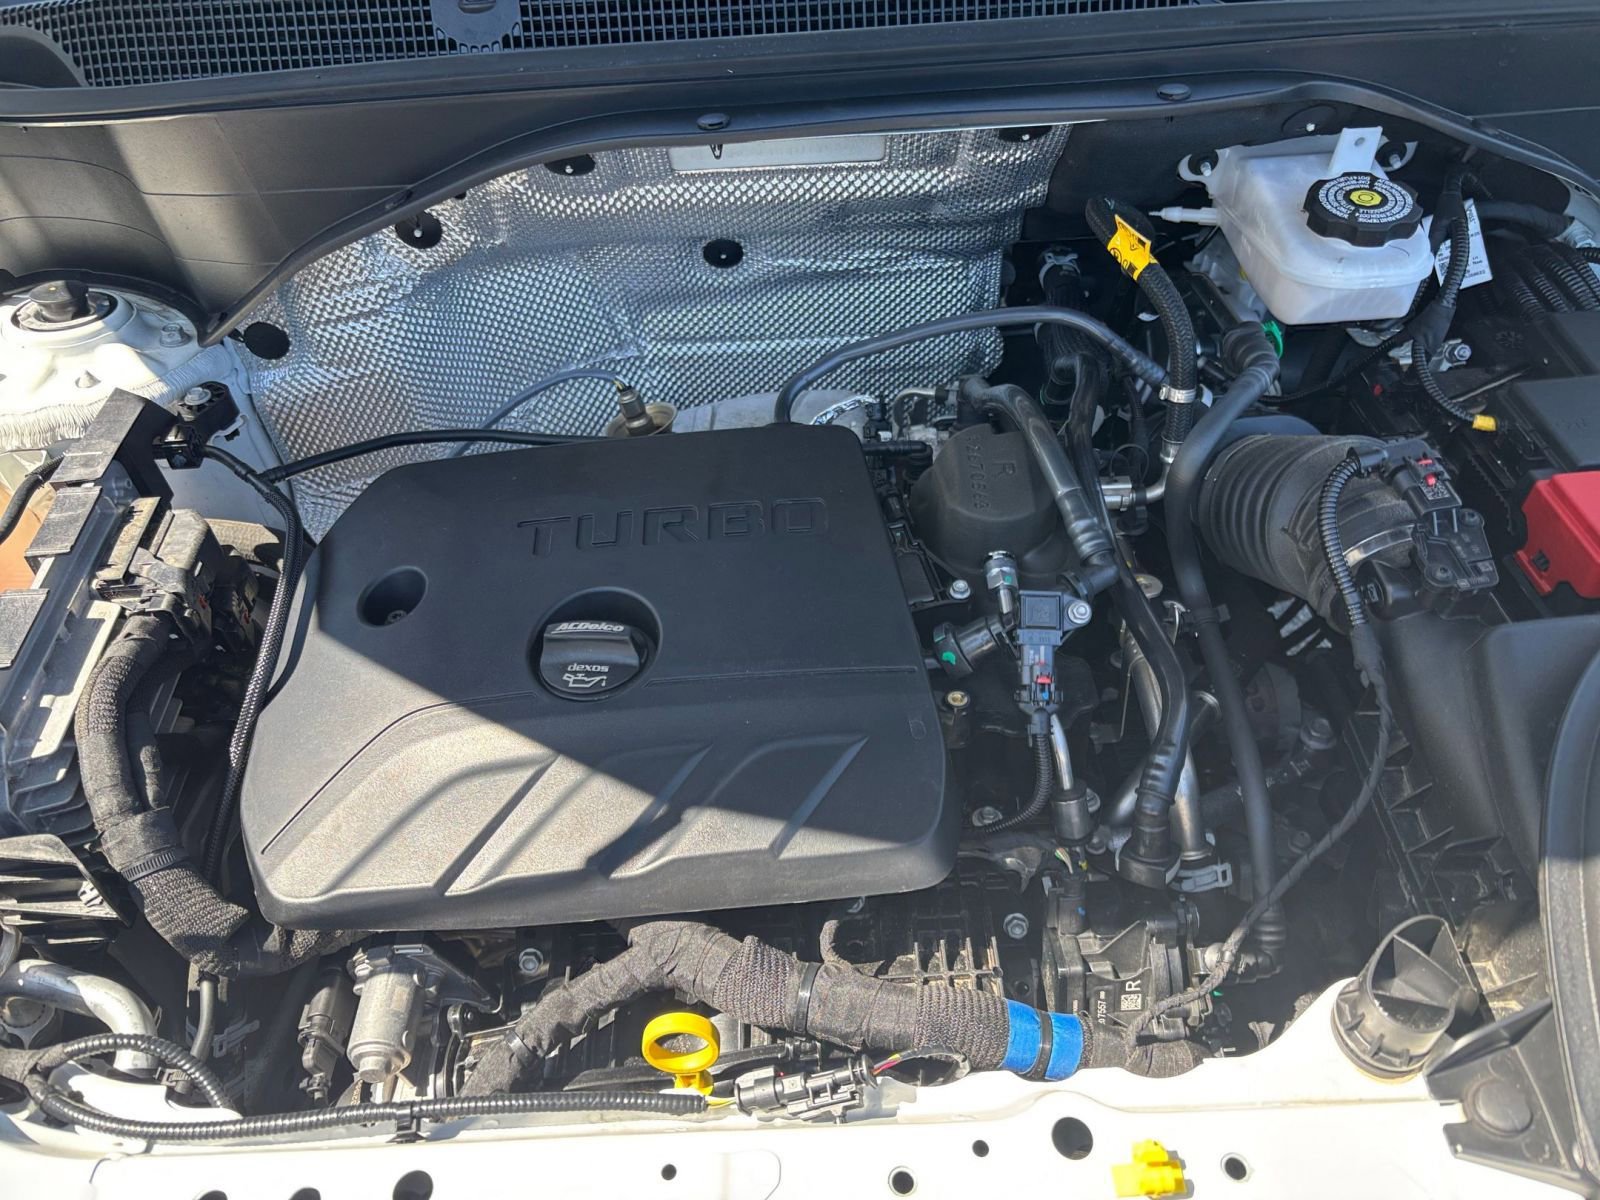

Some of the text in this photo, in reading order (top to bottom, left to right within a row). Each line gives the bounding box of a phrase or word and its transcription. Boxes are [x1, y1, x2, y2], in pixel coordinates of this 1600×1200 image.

[517, 497, 828, 557] TURBO
[551, 622, 625, 633] ACDelco
[567, 663, 610, 673] dexos
[1125, 979, 1141, 992] R
